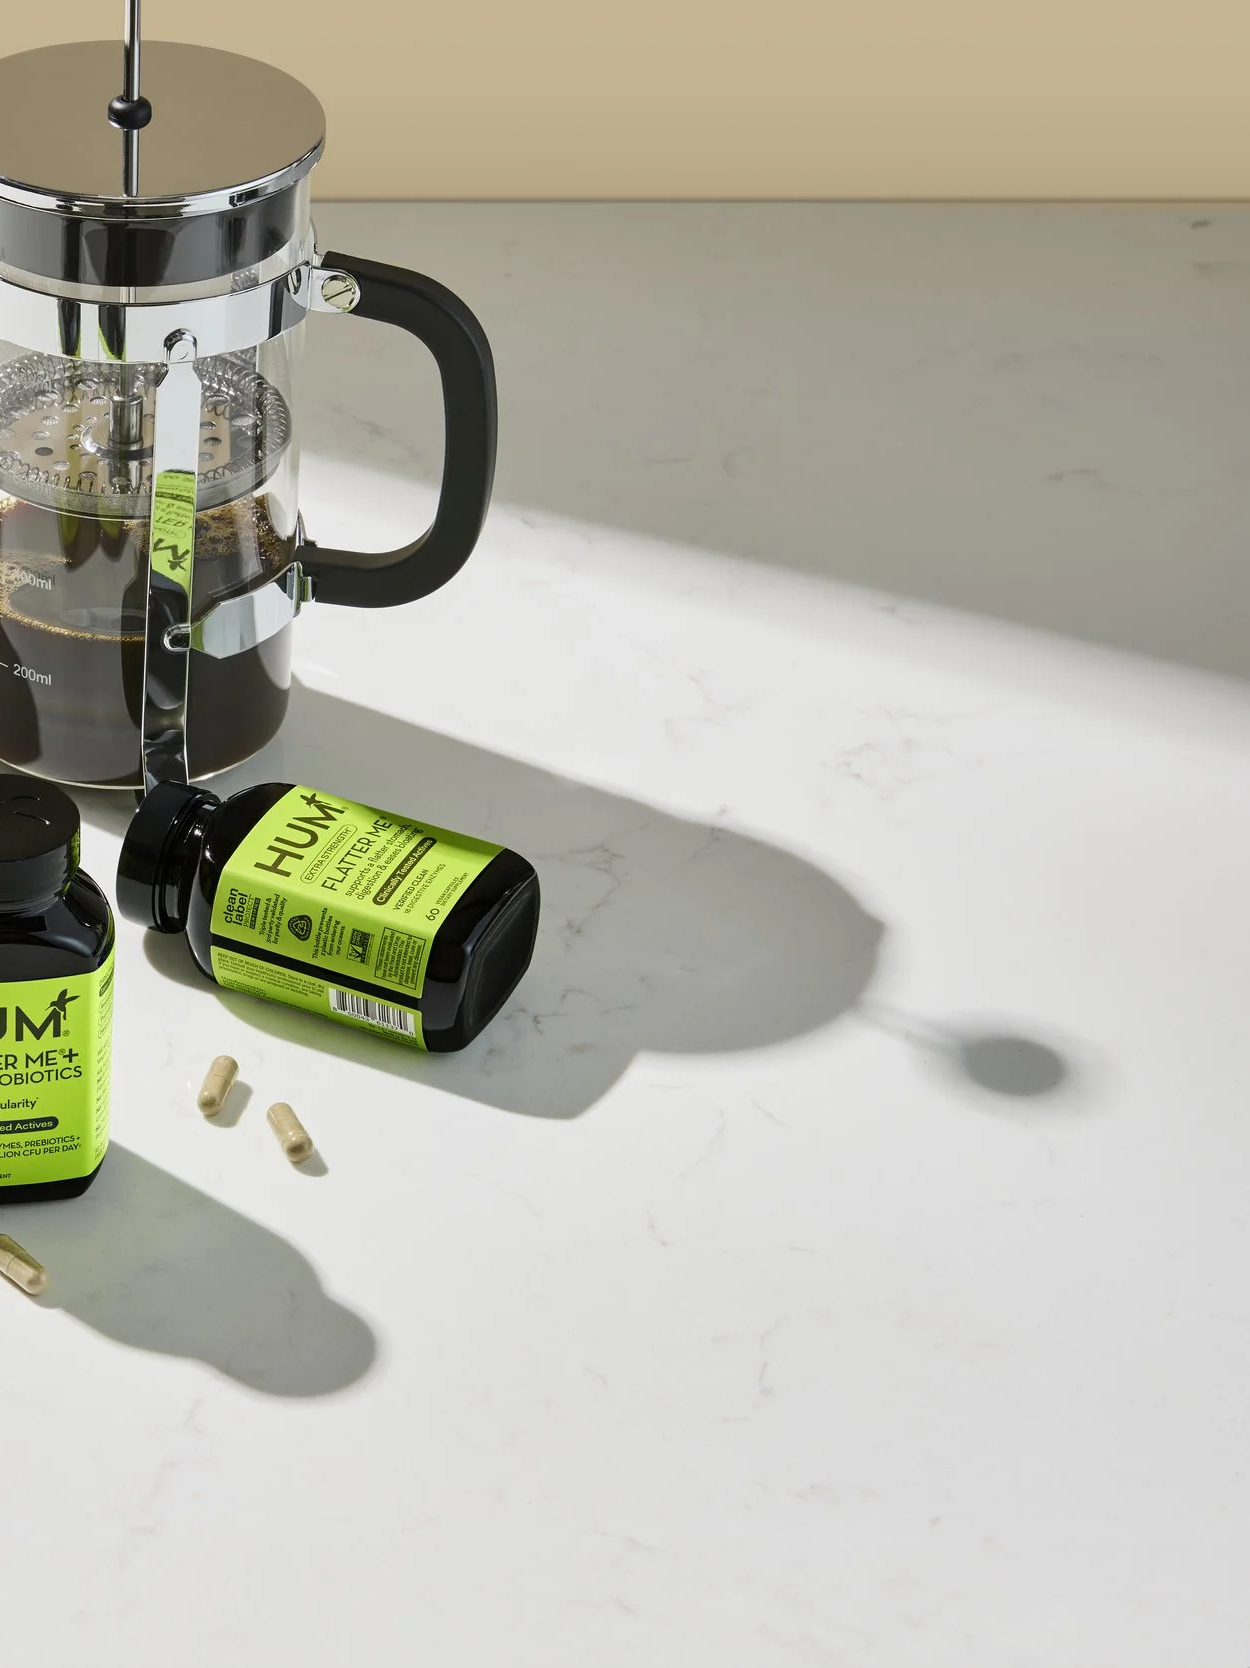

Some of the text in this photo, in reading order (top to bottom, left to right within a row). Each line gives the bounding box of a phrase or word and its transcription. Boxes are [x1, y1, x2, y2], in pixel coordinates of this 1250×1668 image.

[14, 571, 52, 590] 00ml
[13, 664, 52, 686] 200ml
[305, 860, 325, 880] EXTRA
[321, 838, 376, 891] FLATTER
[345, 867, 370, 896] supports
[368, 845, 389, 862] flatter
[355, 871, 383, 900] digestion
[385, 848, 402, 864] eases
[377, 839, 433, 902] Clinically Tested Actives
[393, 868, 429, 910] VERIFIED CLEAN
[223, 888, 239, 923] clean
[232, 892, 248, 925] label
[425, 908, 440, 921] 60
[14, 1119, 53, 1131] Actives
[22, 1149, 41, 1157] CFU
[43, 1146, 60, 1154] PER
[25, 1135, 75, 1147] PREBIOTICS
